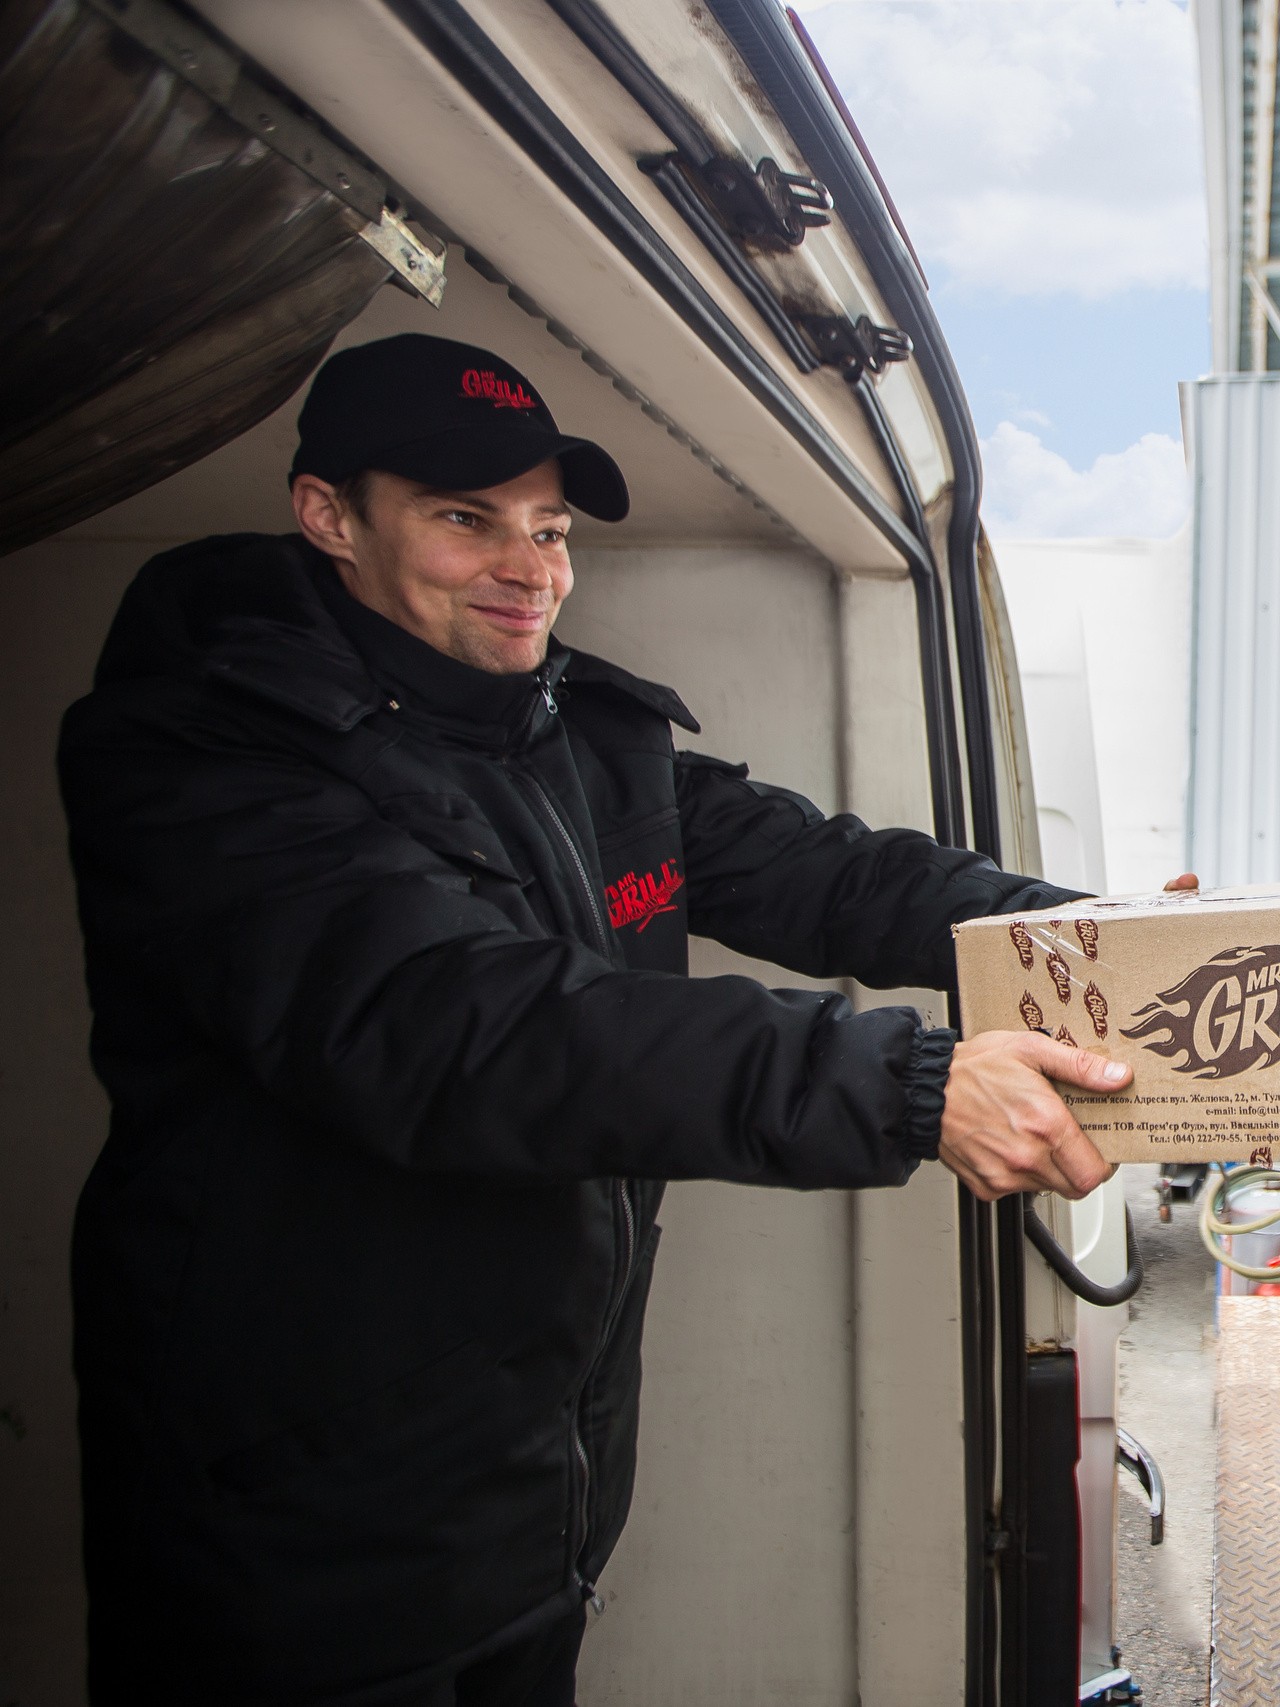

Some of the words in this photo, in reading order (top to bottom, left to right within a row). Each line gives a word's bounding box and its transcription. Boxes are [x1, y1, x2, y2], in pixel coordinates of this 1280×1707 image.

[462, 368, 531, 404] GRILL
[604, 861, 683, 929] GRILL
[618, 871, 637, 891] MR
[1013, 926, 1031, 961] GRILL
[1078, 919, 1096, 958] GRILL
[1022, 1003, 1041, 1031] GRIL
[1087, 995, 1105, 1030] GRILL
[1061, 1094, 1132, 1106] Тульчинм'ясо».
[1134, 1094, 1169, 1105] Адреса:
[1170, 1095, 1189, 1106] вул.
[1190, 1094, 1233, 1104] Желюка,
[1234, 1093, 1249, 1104] 22,
[1205, 1107, 1237, 1116] e-mail:
[1113, 1121, 1134, 1131] ТОВ
[1209, 1123, 1229, 1132] вул.
[1148, 1134, 1170, 1144] Тел.:
[1172, 1133, 1195, 1144] (044)
[1197, 1132, 1243, 1143] 222-79-55.
